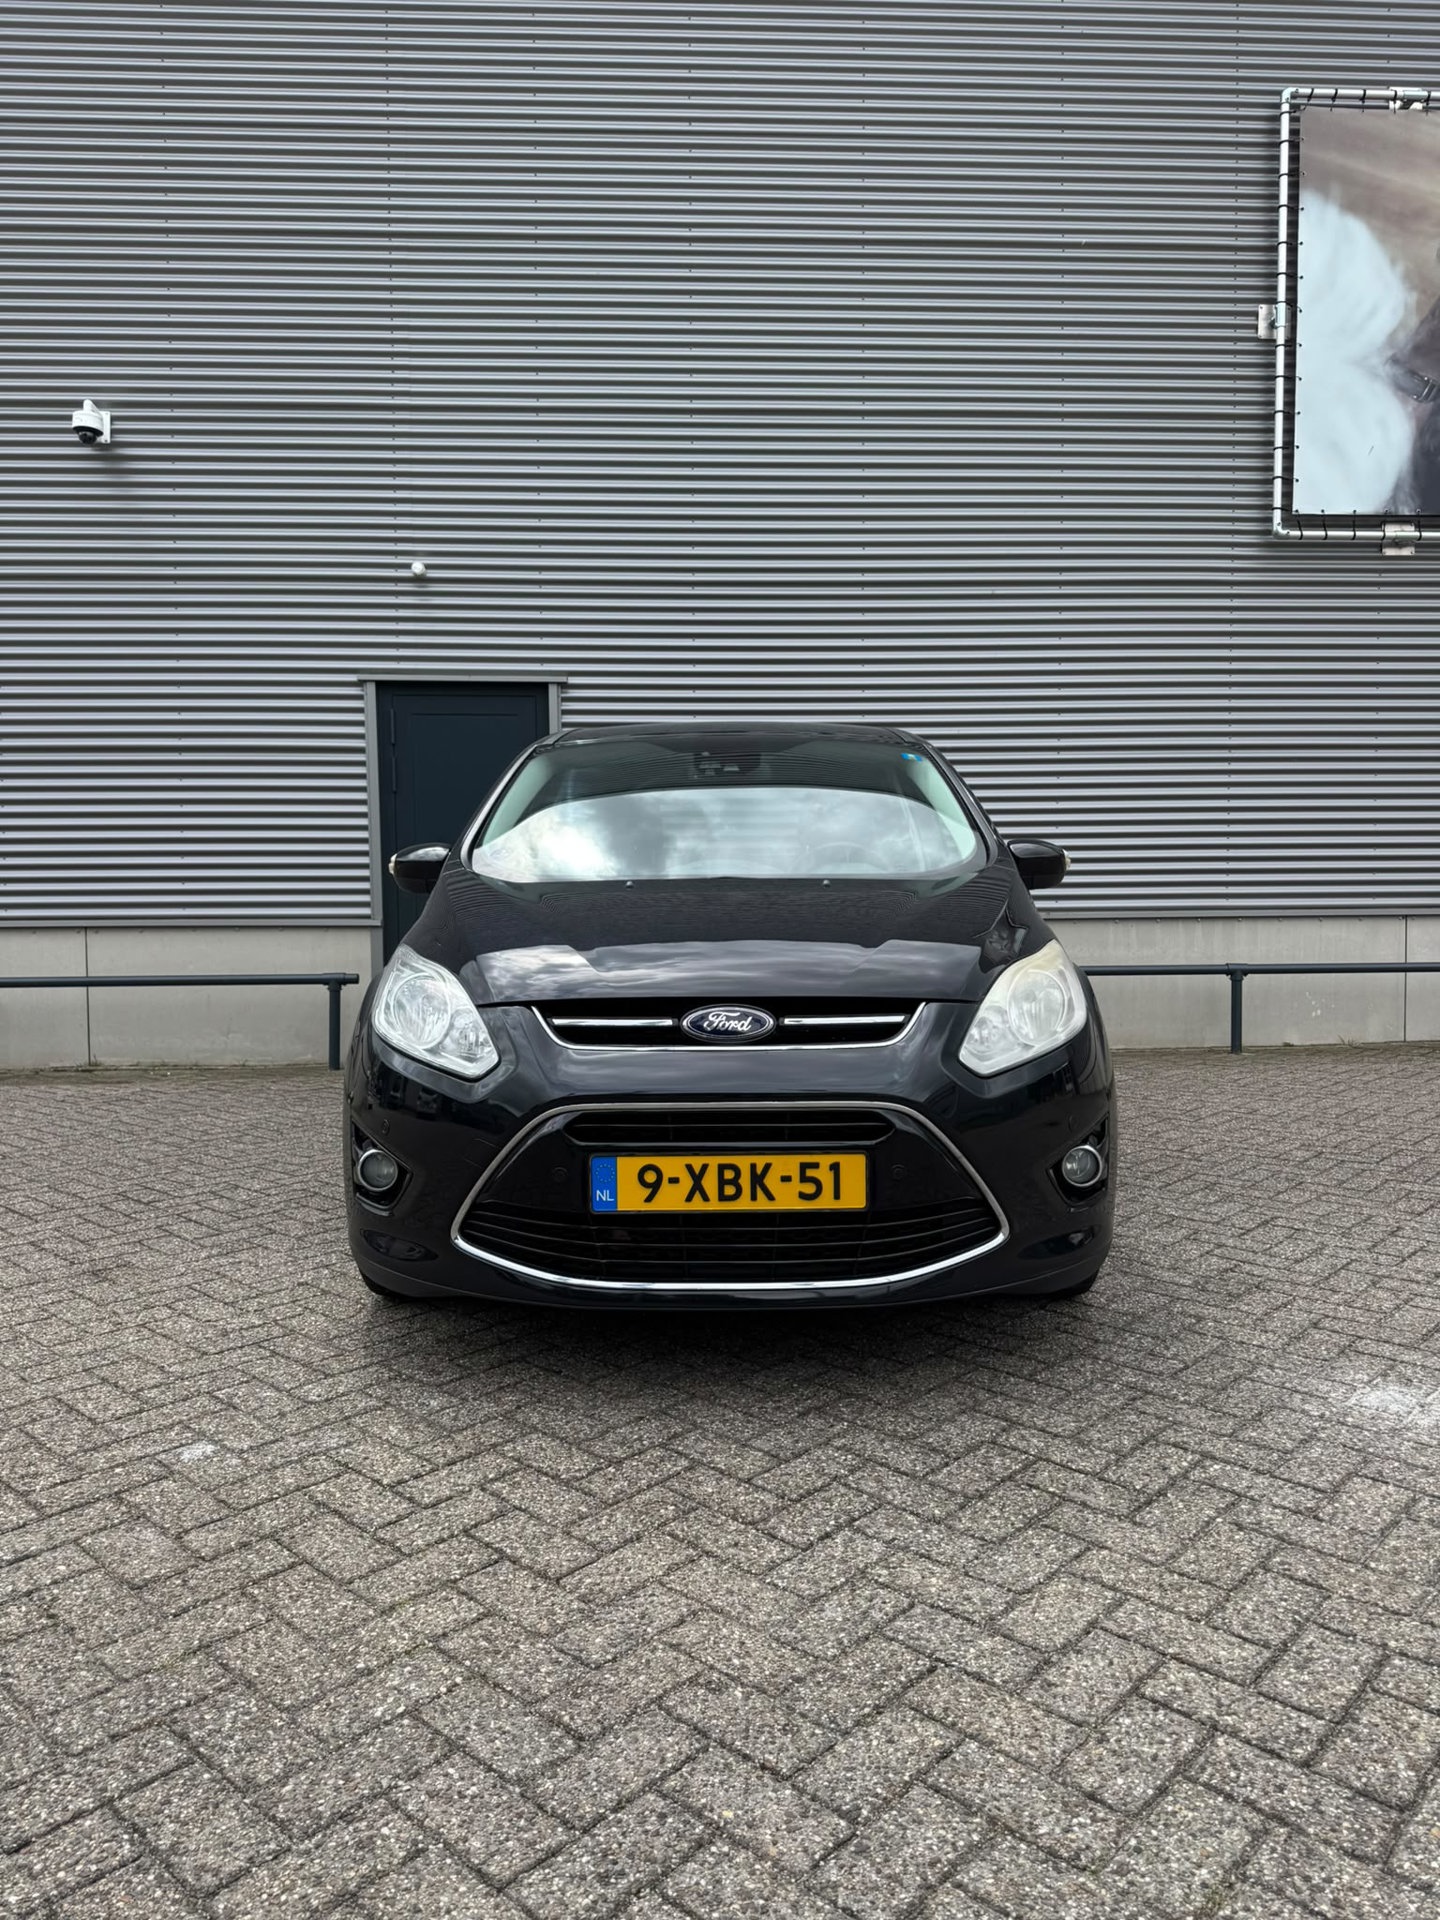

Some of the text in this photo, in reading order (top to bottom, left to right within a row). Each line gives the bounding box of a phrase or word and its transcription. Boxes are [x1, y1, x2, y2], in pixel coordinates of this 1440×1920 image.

[703, 1011, 753, 1031] Ford
[637, 1161, 841, 1203] 9-XBK-51
[596, 1189, 615, 1202] NL
